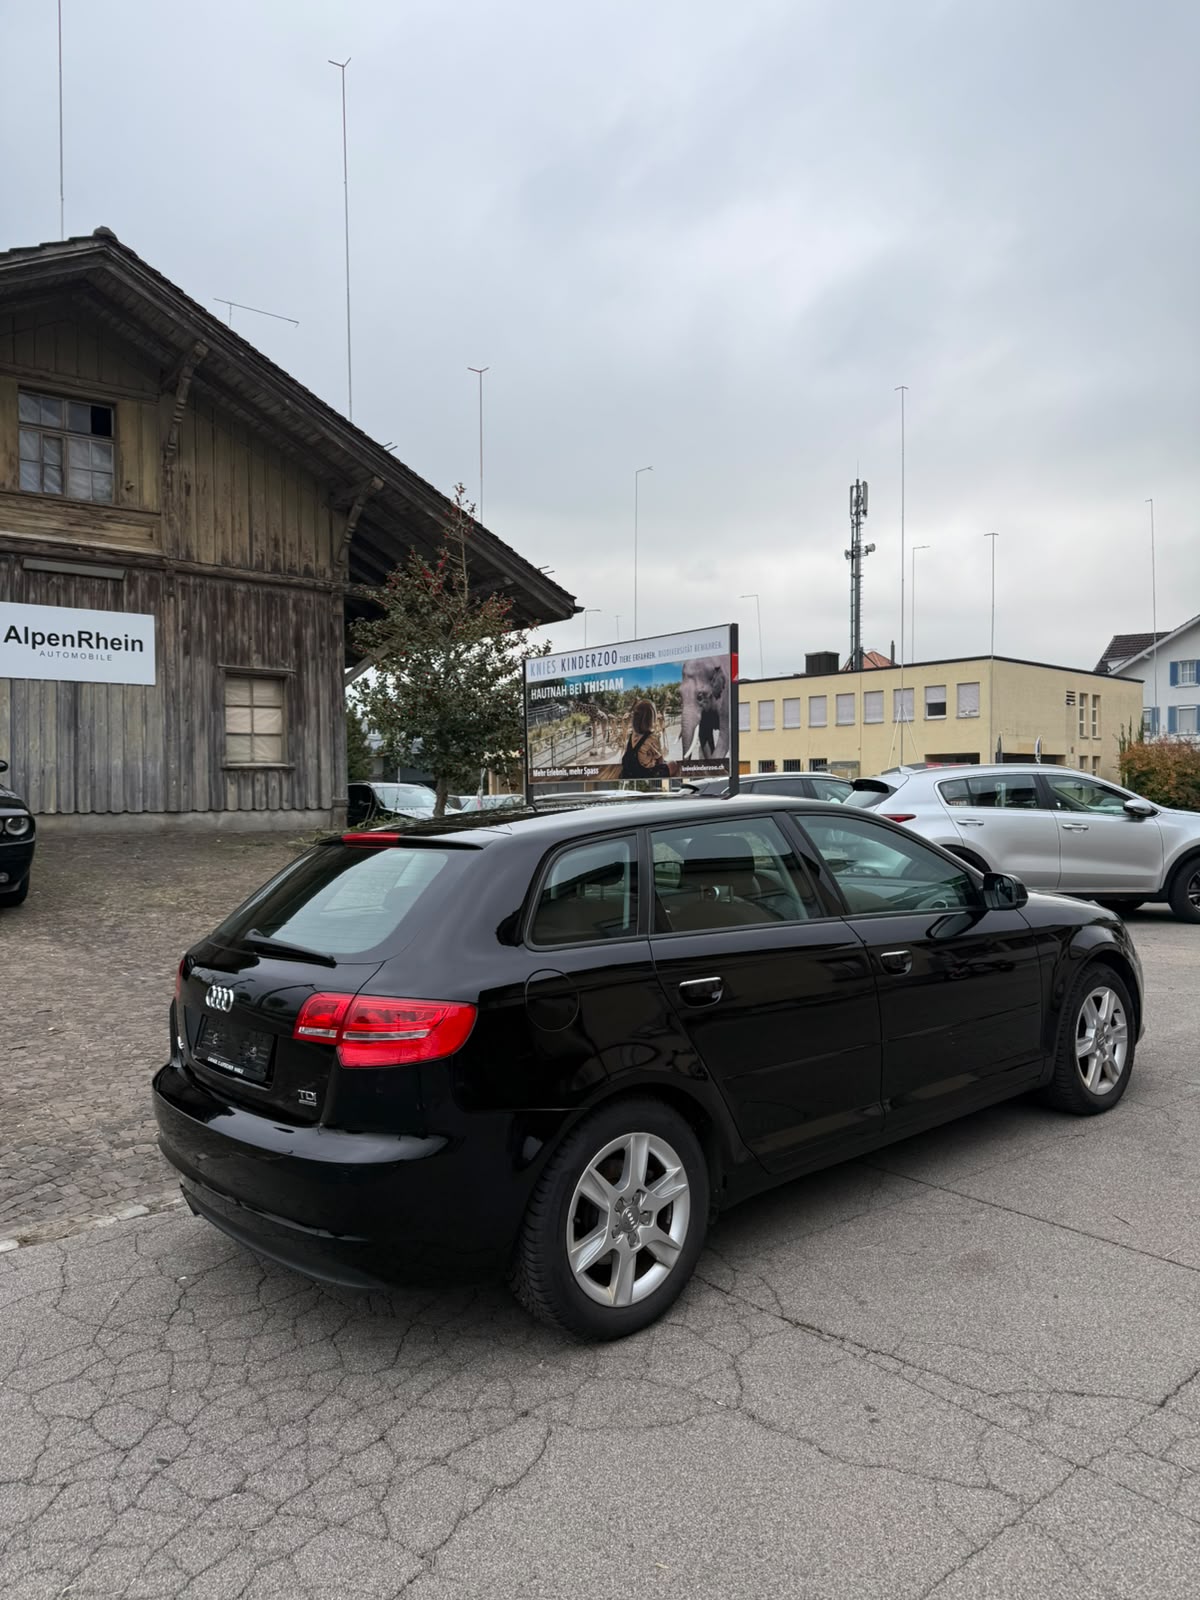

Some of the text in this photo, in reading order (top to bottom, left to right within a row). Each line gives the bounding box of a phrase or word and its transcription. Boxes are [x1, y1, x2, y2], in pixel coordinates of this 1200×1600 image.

[4, 625, 144, 653] AlpenRhein
[39, 650, 113, 661] AUTOMOBILE
[530, 659, 557, 677] KNIES
[561, 649, 618, 673] KINDERZOO
[530, 677, 624, 700] HAUTNAH BEI THISIAM
[532, 768, 546, 777] Mehr
[569, 766, 583, 775] mehr
[583, 766, 599, 777] Spass
[297, 1089, 317, 1102] TDI
